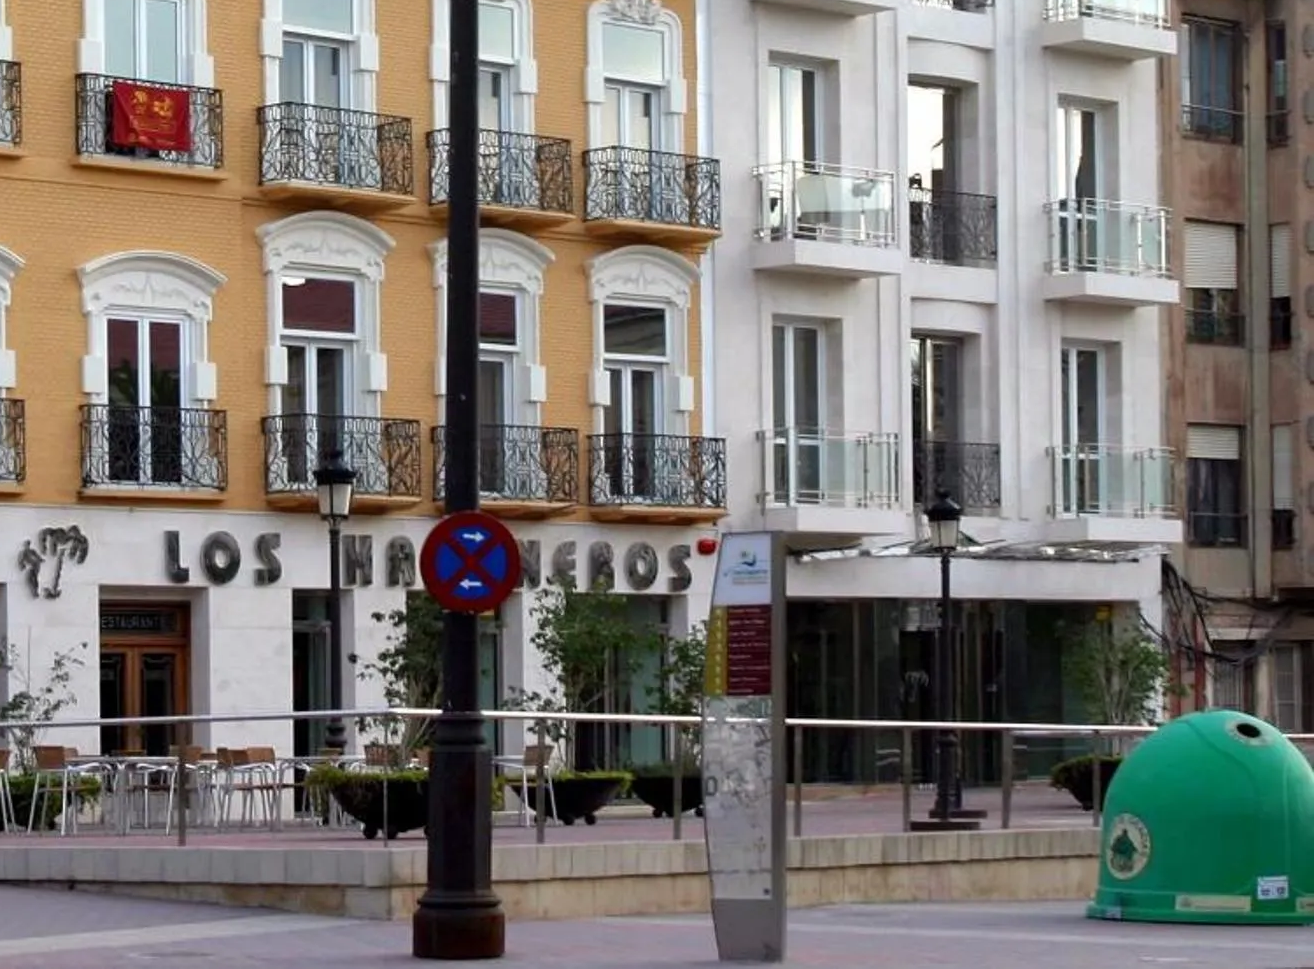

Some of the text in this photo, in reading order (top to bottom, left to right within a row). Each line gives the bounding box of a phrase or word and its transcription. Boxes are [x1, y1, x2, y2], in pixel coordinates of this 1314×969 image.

[166, 530, 282, 585] LOS
[340, 534, 692, 592] HANEROS
[101, 615, 170, 629] ESTAURANTE
